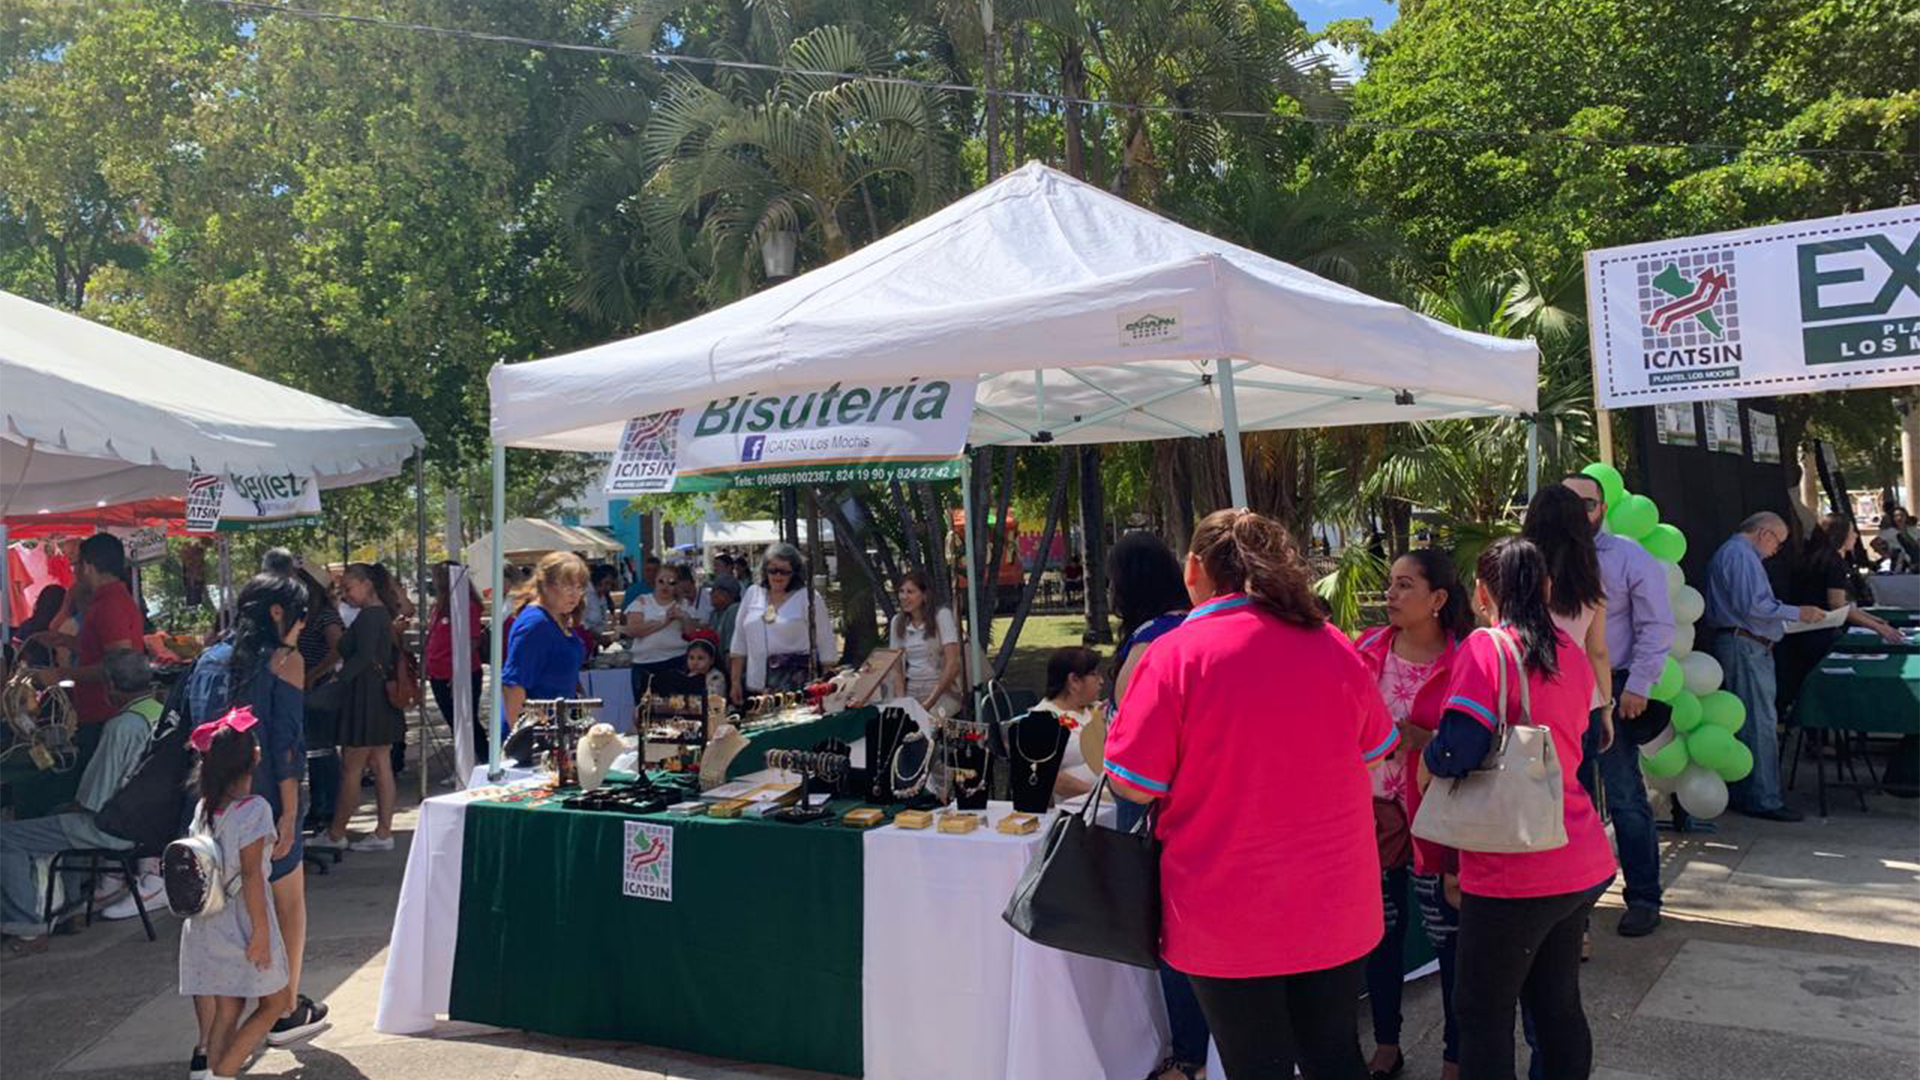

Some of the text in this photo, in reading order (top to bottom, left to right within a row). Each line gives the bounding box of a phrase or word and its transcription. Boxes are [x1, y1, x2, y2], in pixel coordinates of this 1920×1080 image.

[1841, 337, 1898, 357] LOS
[1643, 344, 1743, 370] ICATSIN
[1652, 373, 1687, 383] PLANTEL
[765, 435, 870, 453] ICATSIN Los Mochis
[614, 462, 677, 477] ICATSIN
[836, 469, 854, 481] 824
[857, 468, 870, 481] 19
[871, 468, 885, 479] 90
[887, 470, 894, 483] y
[897, 467, 917, 479] 824
[920, 467, 934, 478] 27
[936, 466, 950, 478] 42
[230, 472, 311, 500] Bellez
